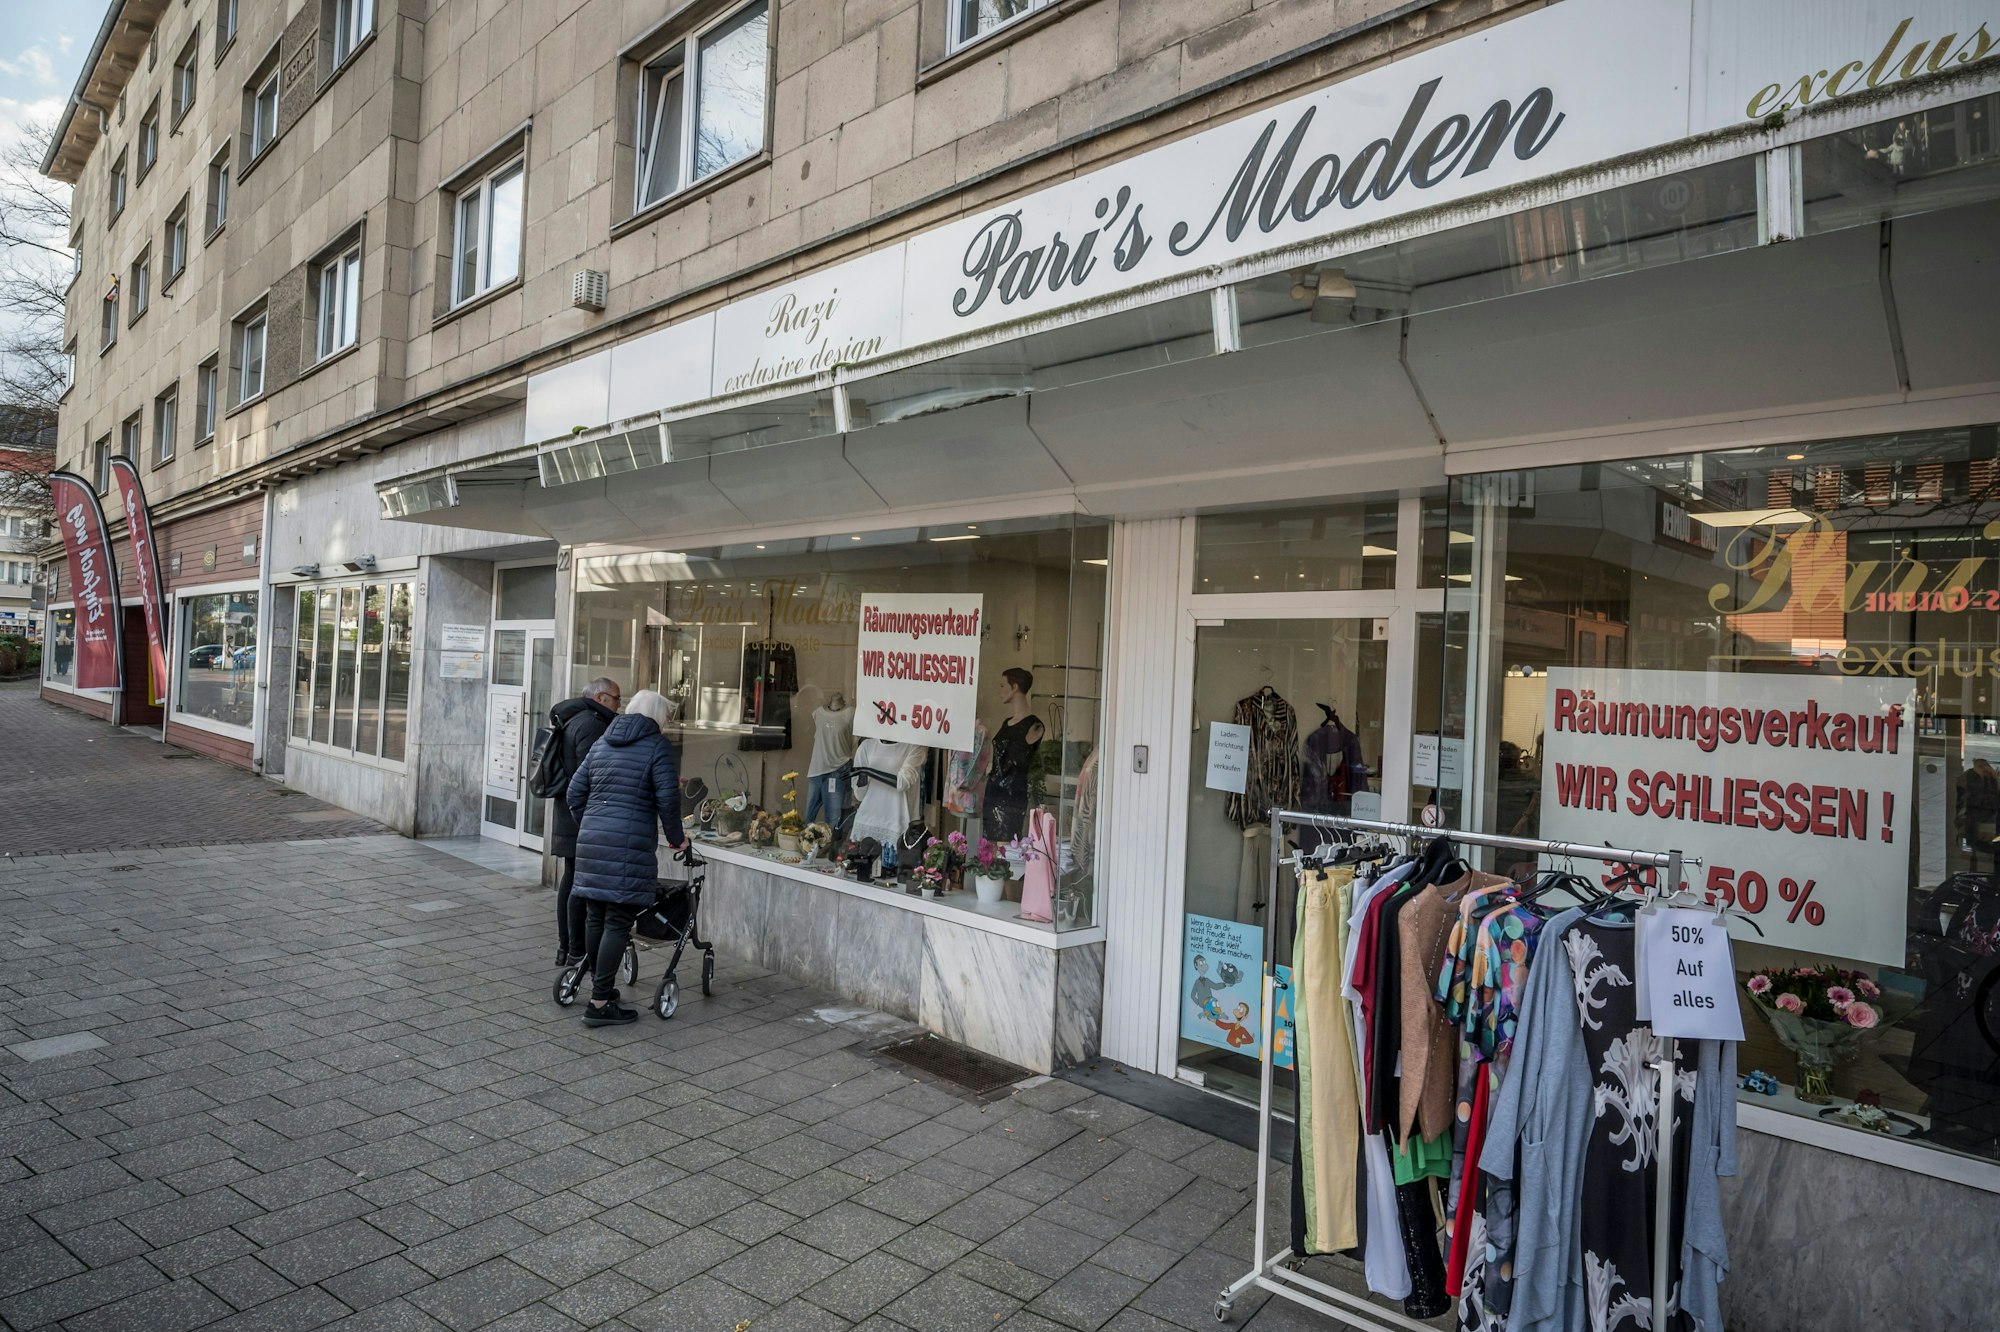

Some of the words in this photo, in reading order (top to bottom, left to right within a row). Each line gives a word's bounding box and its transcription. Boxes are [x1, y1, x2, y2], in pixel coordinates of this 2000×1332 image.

[952, 185, 1153, 317] Pari's
[1168, 75, 1567, 257] Moden
[765, 288, 841, 344] Razi
[724, 357, 805, 393] exclusive
[809, 335, 888, 370] design
[557, 551, 570, 572] 22
[863, 605, 980, 640] Räumungsverkauf
[862, 650, 885, 677] WIR
[887, 651, 966, 684] SCHLIESSEN
[968, 656, 974, 685] !
[911, 704, 933, 730] 50
[936, 708, 950, 734] %
[1554, 687, 1904, 755] Räumungsverkauf
[1214, 741, 1244, 752] Einrichtung
[1213, 762, 1241, 773] verkaufen
[1555, 762, 1618, 812] WIR
[1626, 768, 1869, 842] SCHLIESSEN
[1880, 790, 1894, 844] !
[1704, 865, 1769, 914] 50
[1777, 876, 1826, 926] %
[1190, 926, 1205, 935] nicht
[1206, 929, 1226, 939] Freude
[1671, 925, 1704, 945] 50%
[1190, 942, 1204, 950] nicht
[1207, 944, 1226, 955] Freude
[1676, 958, 1704, 977] Auf
[1673, 990, 1715, 1009] alles
